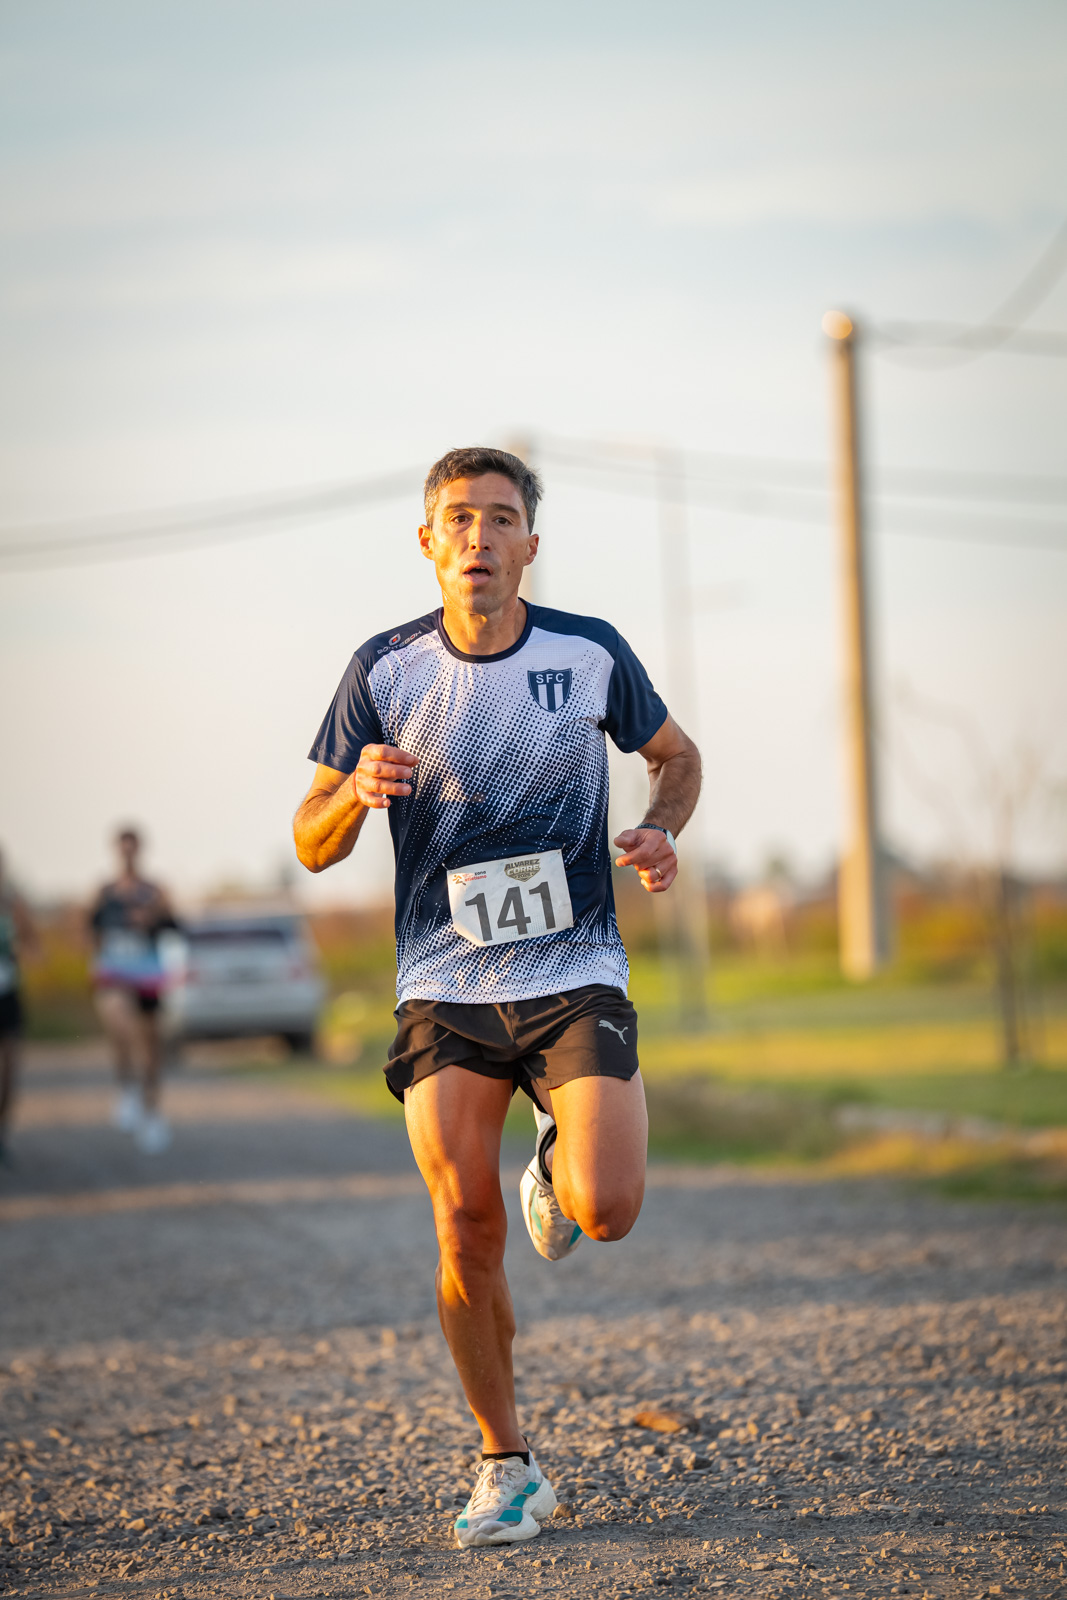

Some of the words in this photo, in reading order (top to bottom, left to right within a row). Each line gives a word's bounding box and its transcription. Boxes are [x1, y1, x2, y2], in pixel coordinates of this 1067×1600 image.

[535, 672, 565, 684] SFC
[504, 859, 541, 871] ALVAREZ
[506, 864, 541, 875] CORRE
[465, 881, 556, 942] 141
